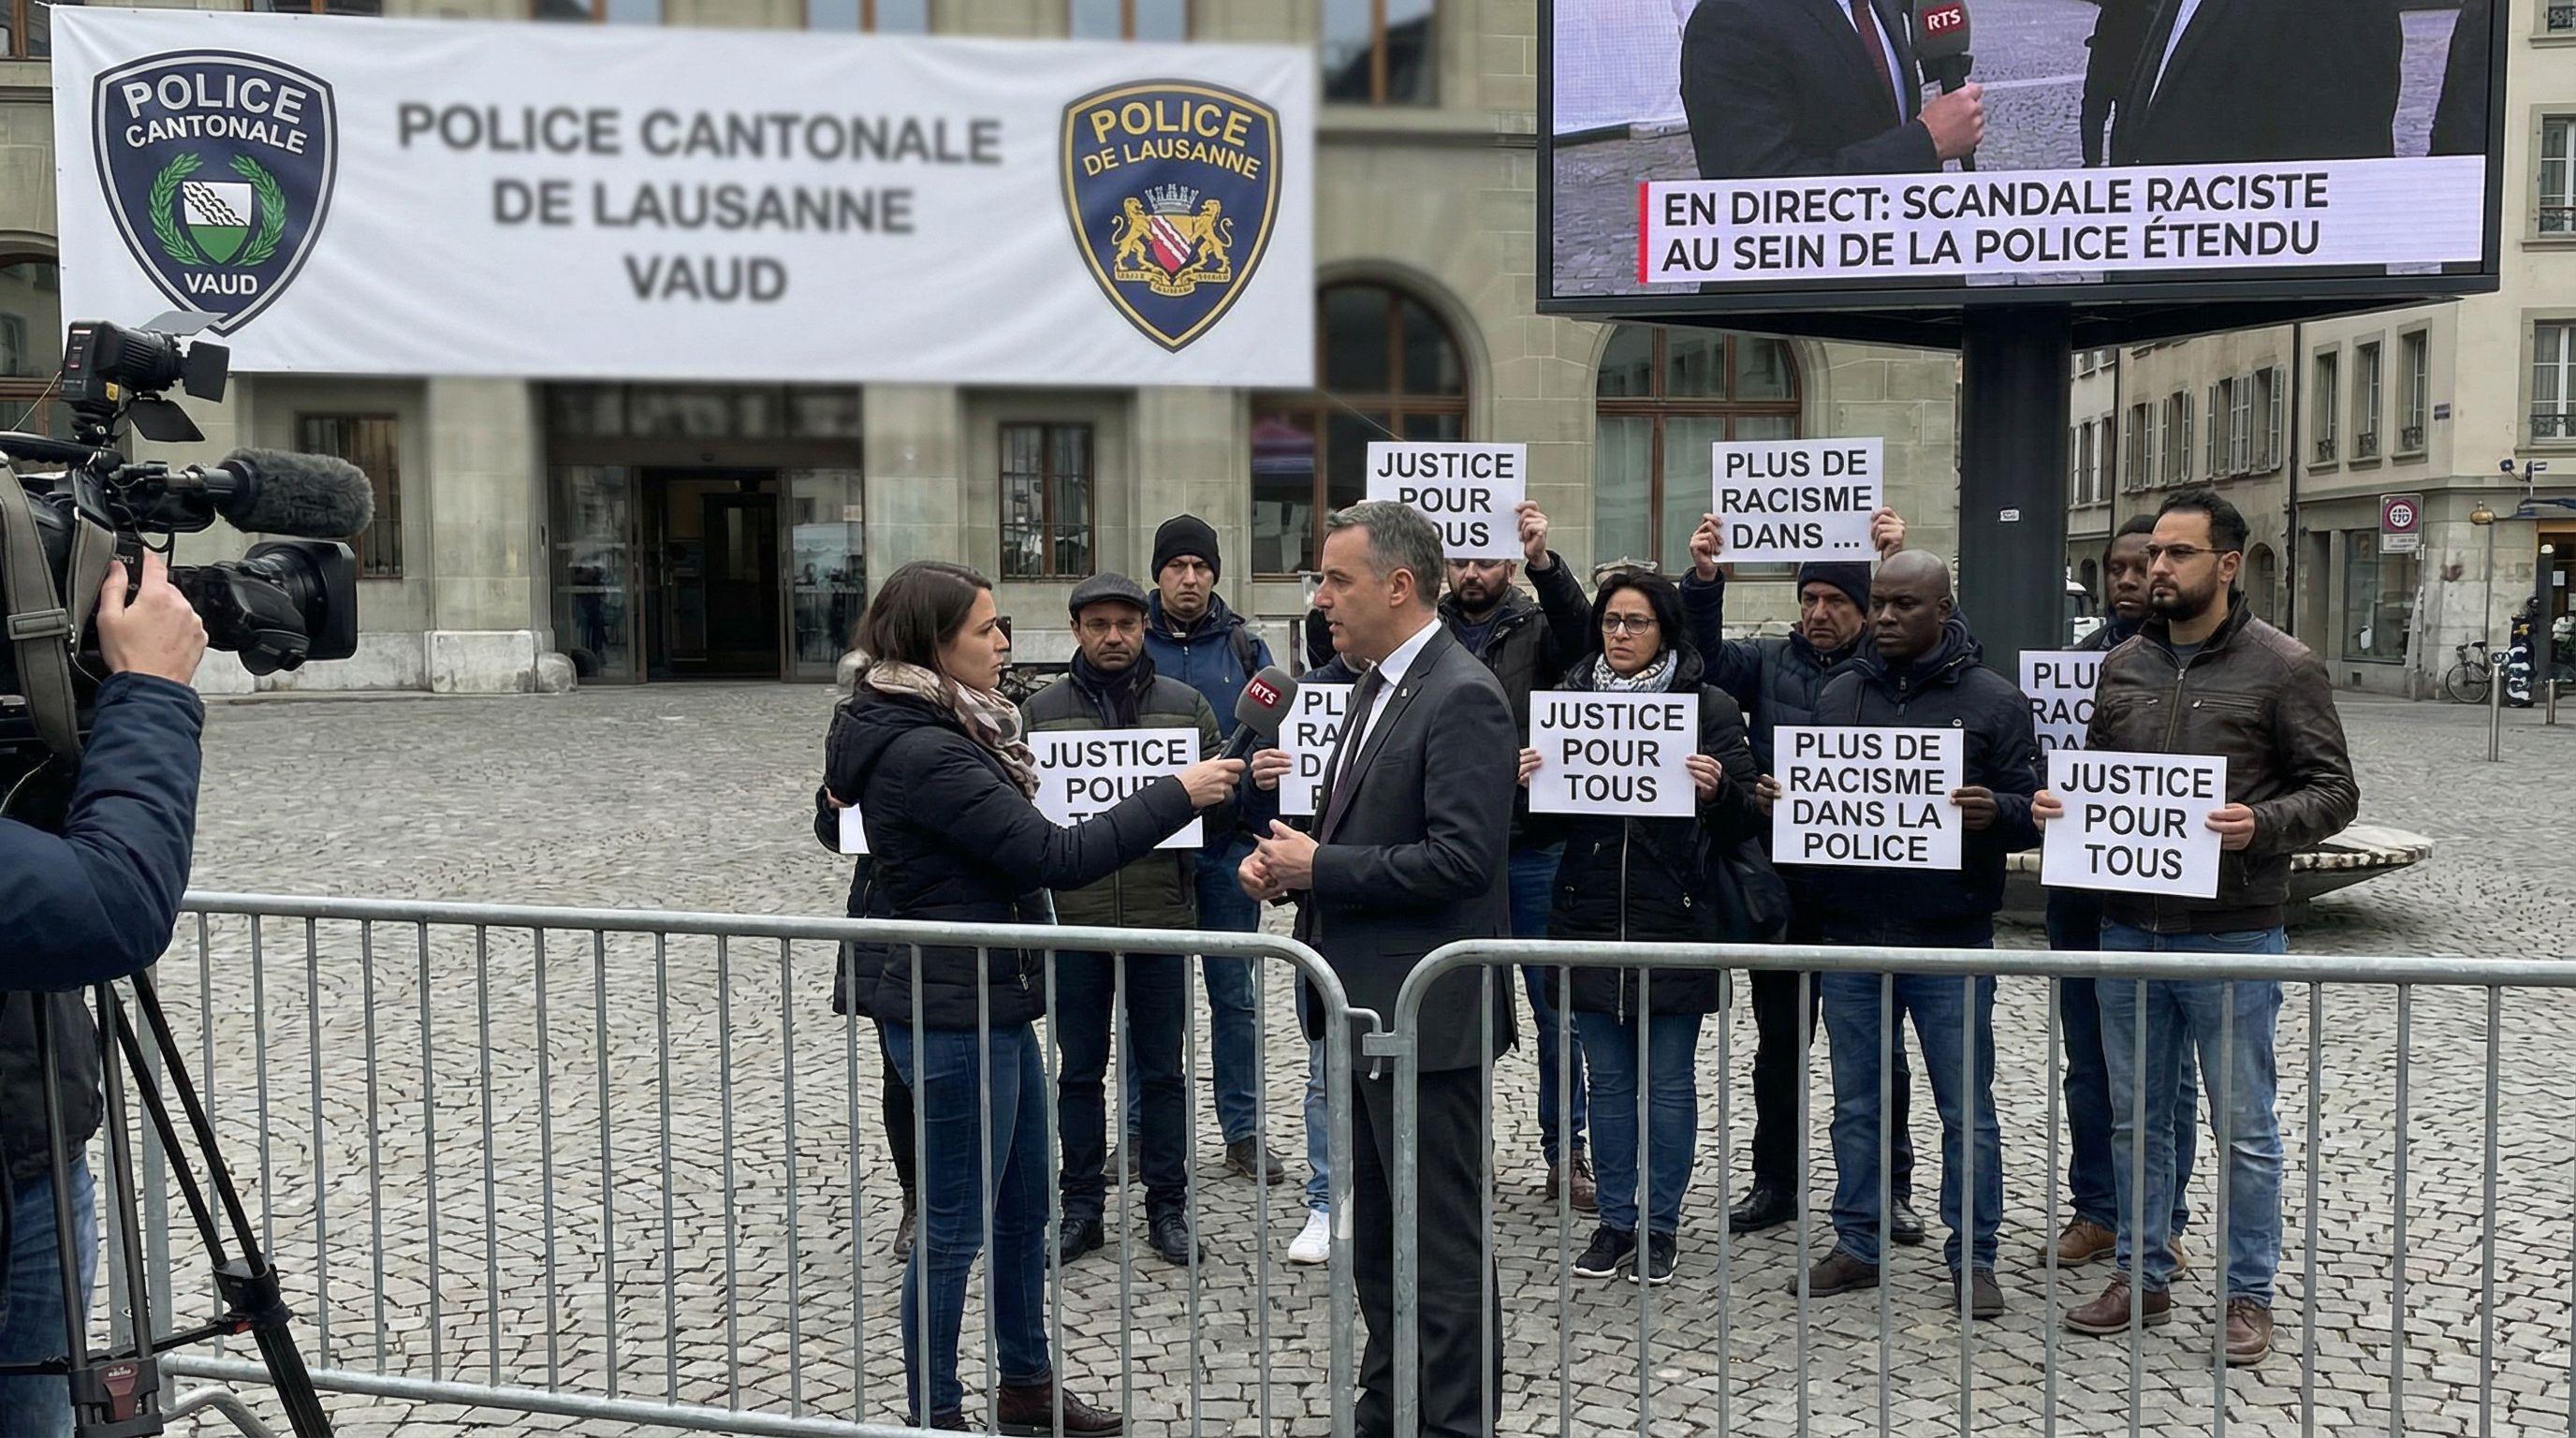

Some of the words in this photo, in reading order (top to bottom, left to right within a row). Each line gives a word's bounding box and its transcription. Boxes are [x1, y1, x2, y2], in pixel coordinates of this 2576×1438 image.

[1927, 8, 1961, 30] RTS
[123, 73, 307, 125] POLICE
[125, 115, 308, 154] CANTONALE
[399, 103, 620, 154] POLICE
[640, 110, 1001, 165] CANTONALE
[1090, 100, 1252, 147] POLICE
[1082, 147, 1120, 176] DE
[1123, 139, 1262, 180] LAUSANNE
[493, 179, 571, 226] DE
[593, 183, 913, 234] LAUSANNE
[1665, 193, 1715, 226] EN
[1732, 187, 1889, 225] DIRECT:
[1903, 179, 2131, 219] SCANDALE
[2147, 173, 2328, 212] RACISTE
[1661, 238, 1719, 271] AU
[1734, 235, 1823, 270] SEIN
[1840, 232, 1894, 267] DE
[1910, 230, 1961, 265] LA
[1976, 226, 2128, 263] POLICE
[2144, 215, 2319, 258] ÉTENDU
[183, 272, 258, 296] VAUD
[625, 256, 786, 301] VAUD
[1378, 453, 1514, 478] JUSTICE
[1727, 451, 1809, 477] PLUS
[1823, 449, 1866, 476] DE
[1399, 487, 1492, 513] POUR
[1722, 486, 1872, 513] RACISME
[1431, 521, 1489, 547] US
[1734, 523, 1822, 549] DANS
[2034, 662, 2102, 689] PLU
[1251, 682, 1278, 705] RTS
[1541, 703, 1684, 730] JUSTICE
[1041, 740, 1187, 769] JUSTICE
[1563, 739, 1661, 767] POUR
[1796, 733, 1881, 759] PLUS
[1895, 735, 1940, 760] DE
[1564, 774, 1657, 802] TOUS
[1791, 767, 1944, 795] RACISME
[2061, 763, 2213, 798] JUSTICE
[1793, 800, 1884, 827] DANS
[1899, 802, 1941, 829] LA
[2086, 804, 2187, 839] POUR
[1805, 833, 1927, 861] POLICE
[2086, 844, 2182, 879] TOUS
